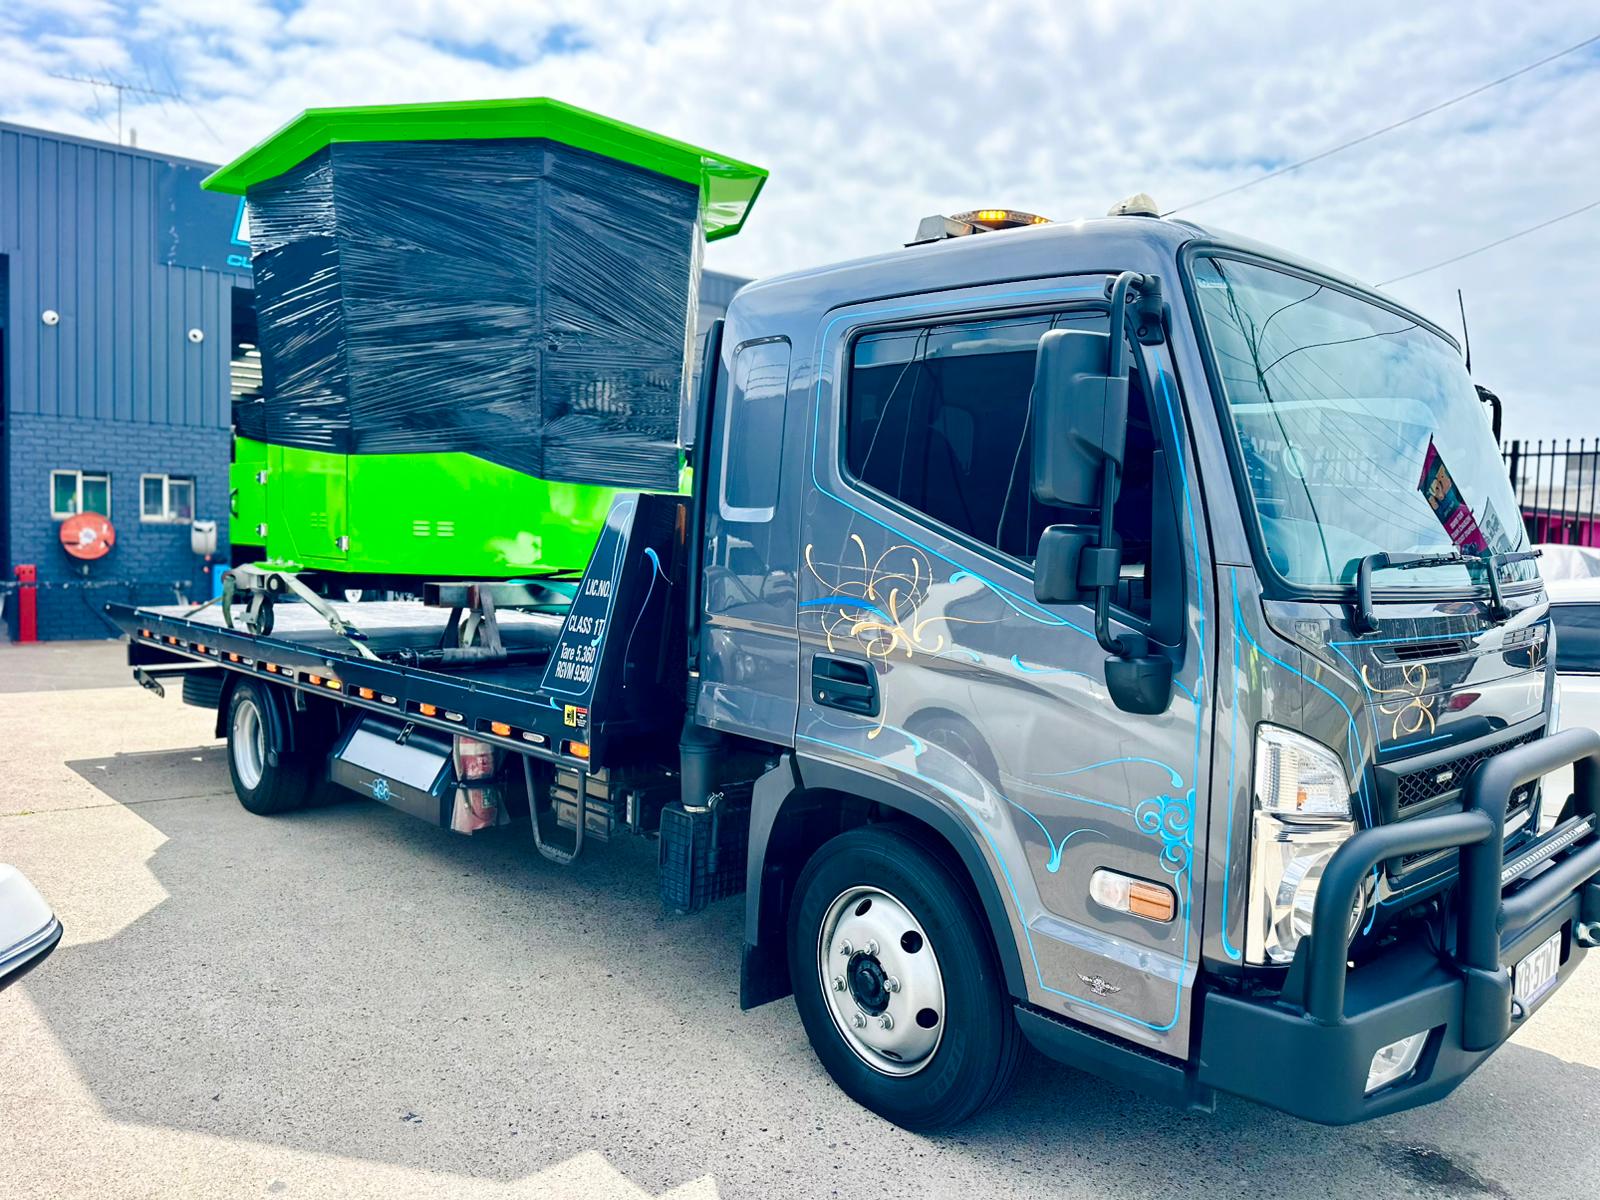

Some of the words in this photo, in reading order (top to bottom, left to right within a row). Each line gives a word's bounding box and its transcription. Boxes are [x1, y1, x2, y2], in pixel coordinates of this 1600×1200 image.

[568, 615, 593, 635] CLASS
[561, 642, 575, 660] Tare
[576, 645, 596, 663] 5.360
